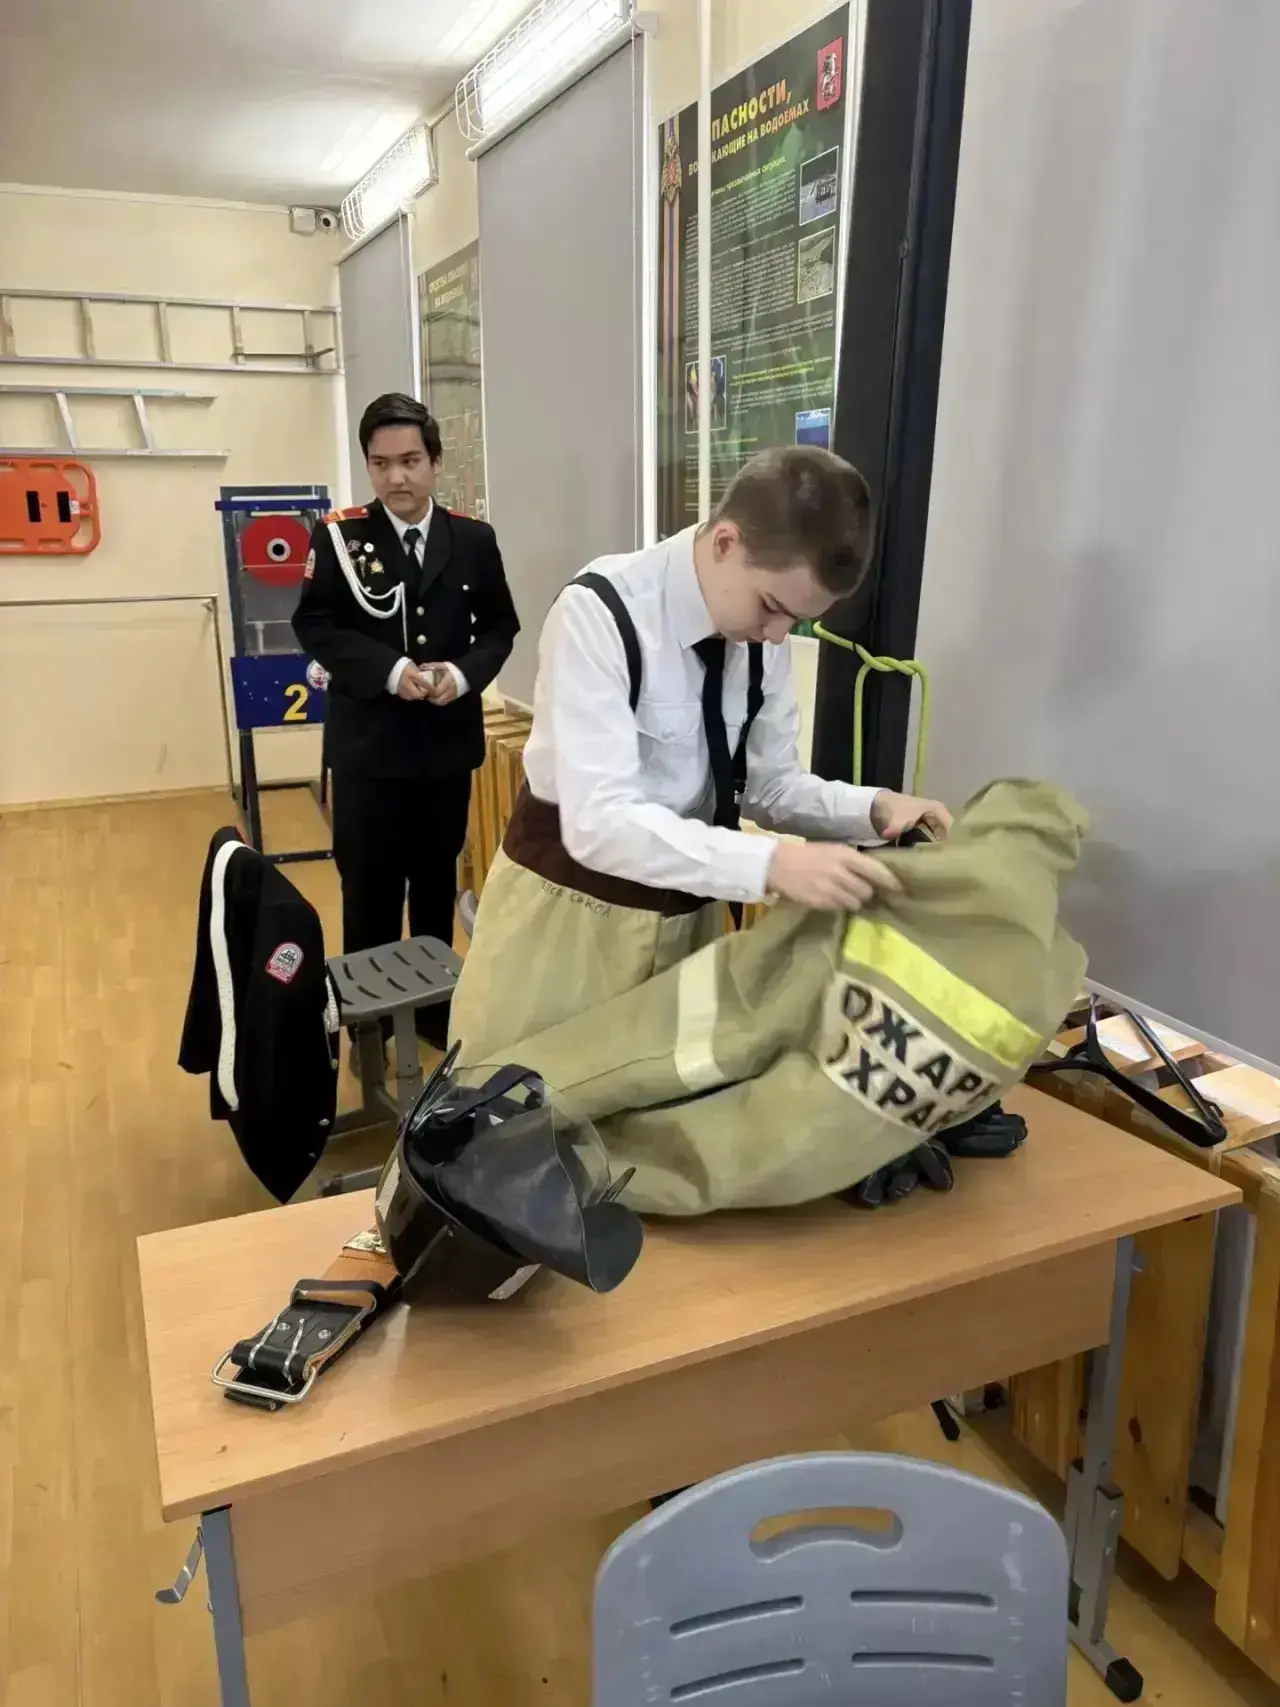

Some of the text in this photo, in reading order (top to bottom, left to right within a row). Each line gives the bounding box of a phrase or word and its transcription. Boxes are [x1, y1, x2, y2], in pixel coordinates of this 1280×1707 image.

[711, 79, 792, 141] ПАСНОСТИ,
[747, 128, 759, 145] НА
[760, 98, 809, 138] ВОДОЕМАХ
[283, 683, 309, 721] 2
[842, 983, 997, 1105] ОЖАР
